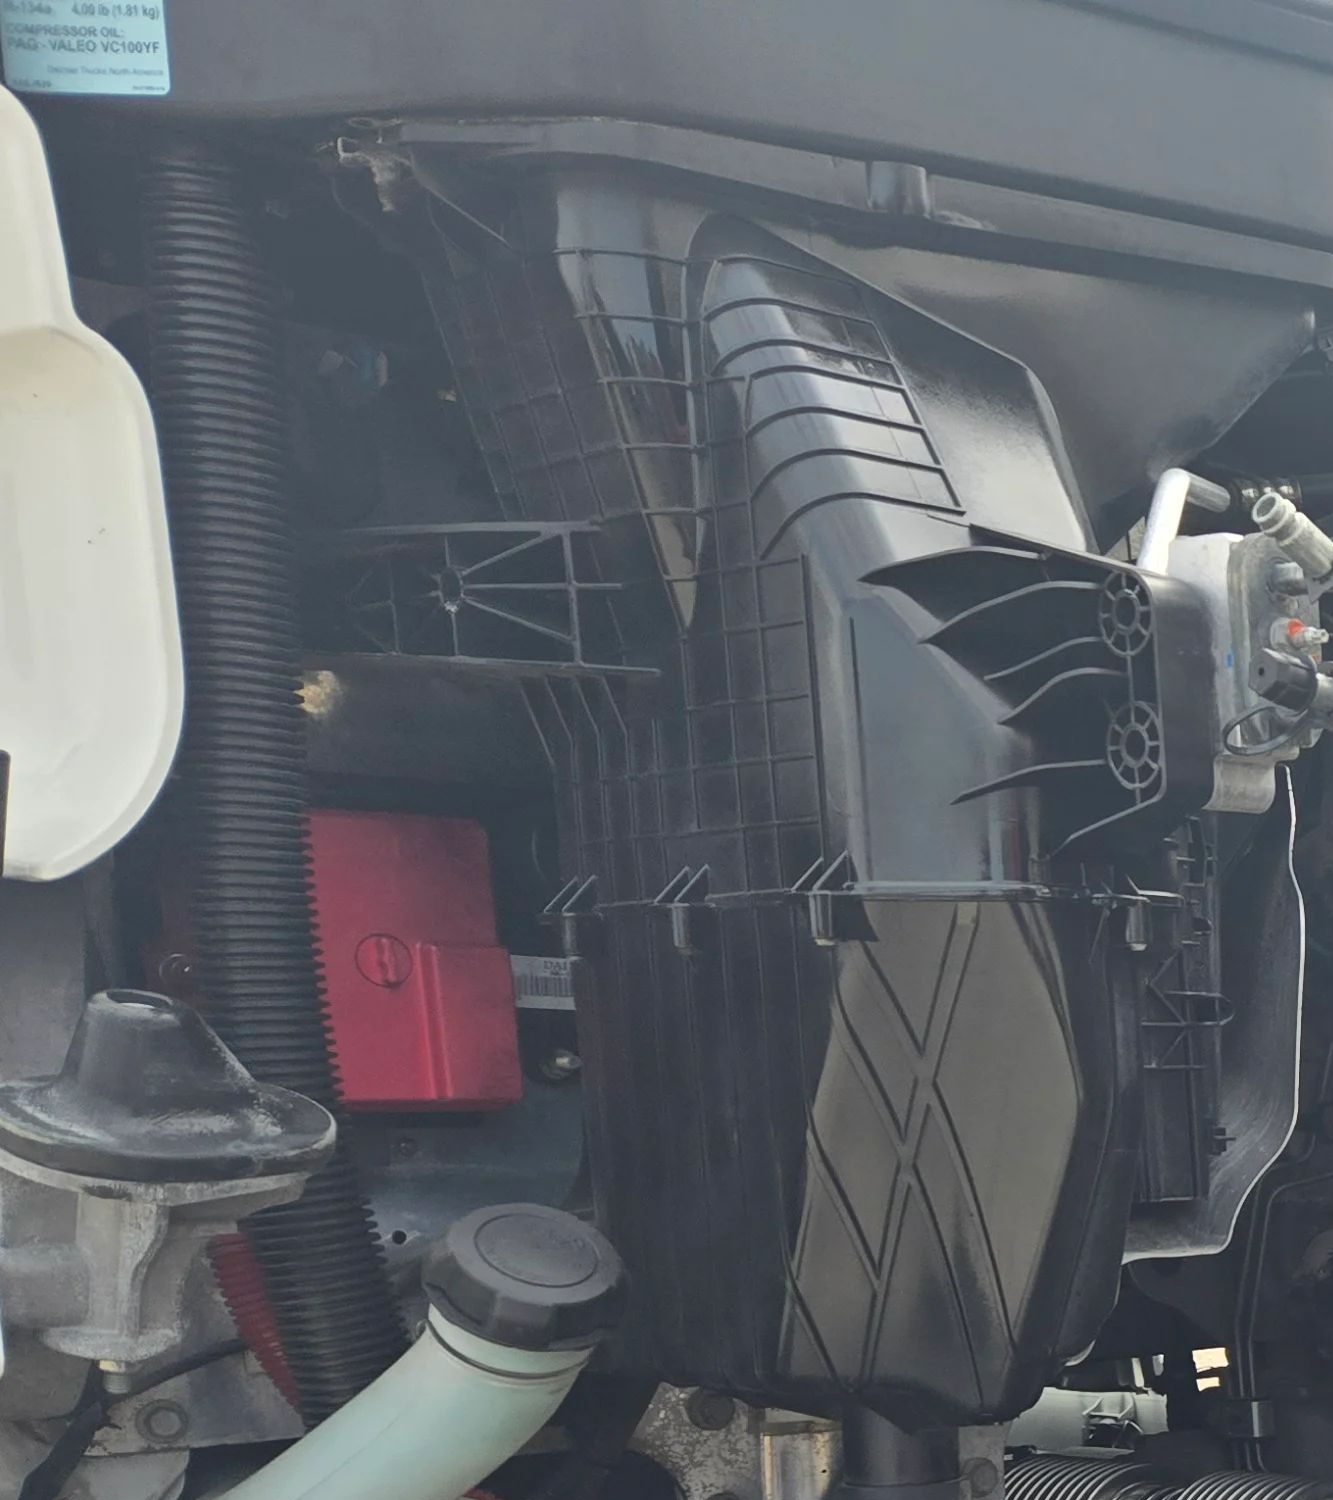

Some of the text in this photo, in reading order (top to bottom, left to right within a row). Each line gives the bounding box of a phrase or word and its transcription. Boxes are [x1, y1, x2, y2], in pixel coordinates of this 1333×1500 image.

[71, 3, 95, 16] 4.00
[98, 4, 110, 16] lb
[112, 4, 139, 19] (1.81
[142, 4, 160, 20] kg)
[6, 22, 125, 38] COMPRESSOR OIL:
[49, 39, 97, 52] VALEO
[100, 40, 159, 54] VC100YF
